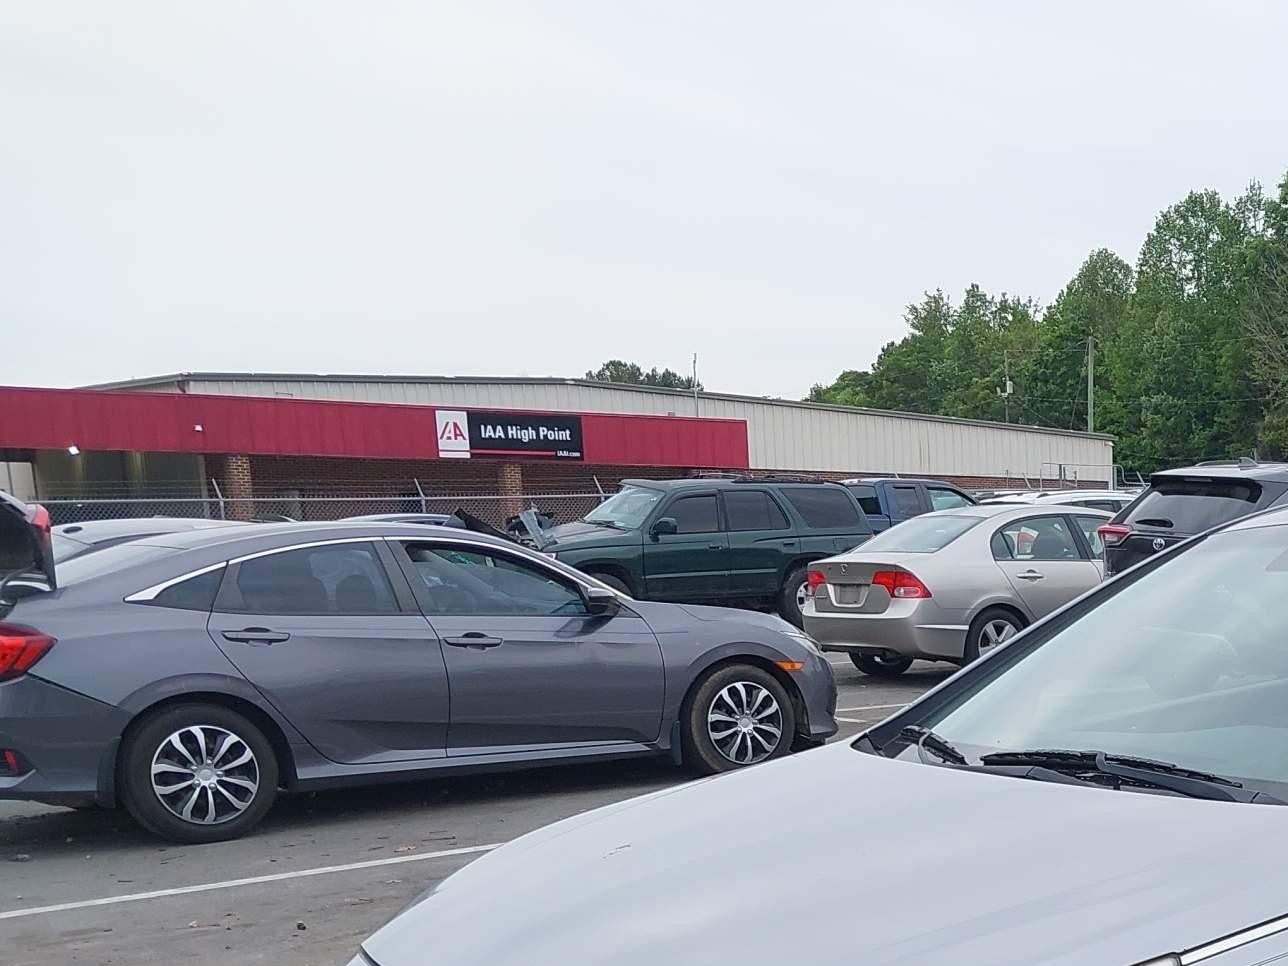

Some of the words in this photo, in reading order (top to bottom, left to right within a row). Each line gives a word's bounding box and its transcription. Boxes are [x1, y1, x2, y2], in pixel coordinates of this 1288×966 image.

[480, 424, 506, 439] IAA
[508, 426, 537, 442] High
[540, 427, 571, 441] Point
